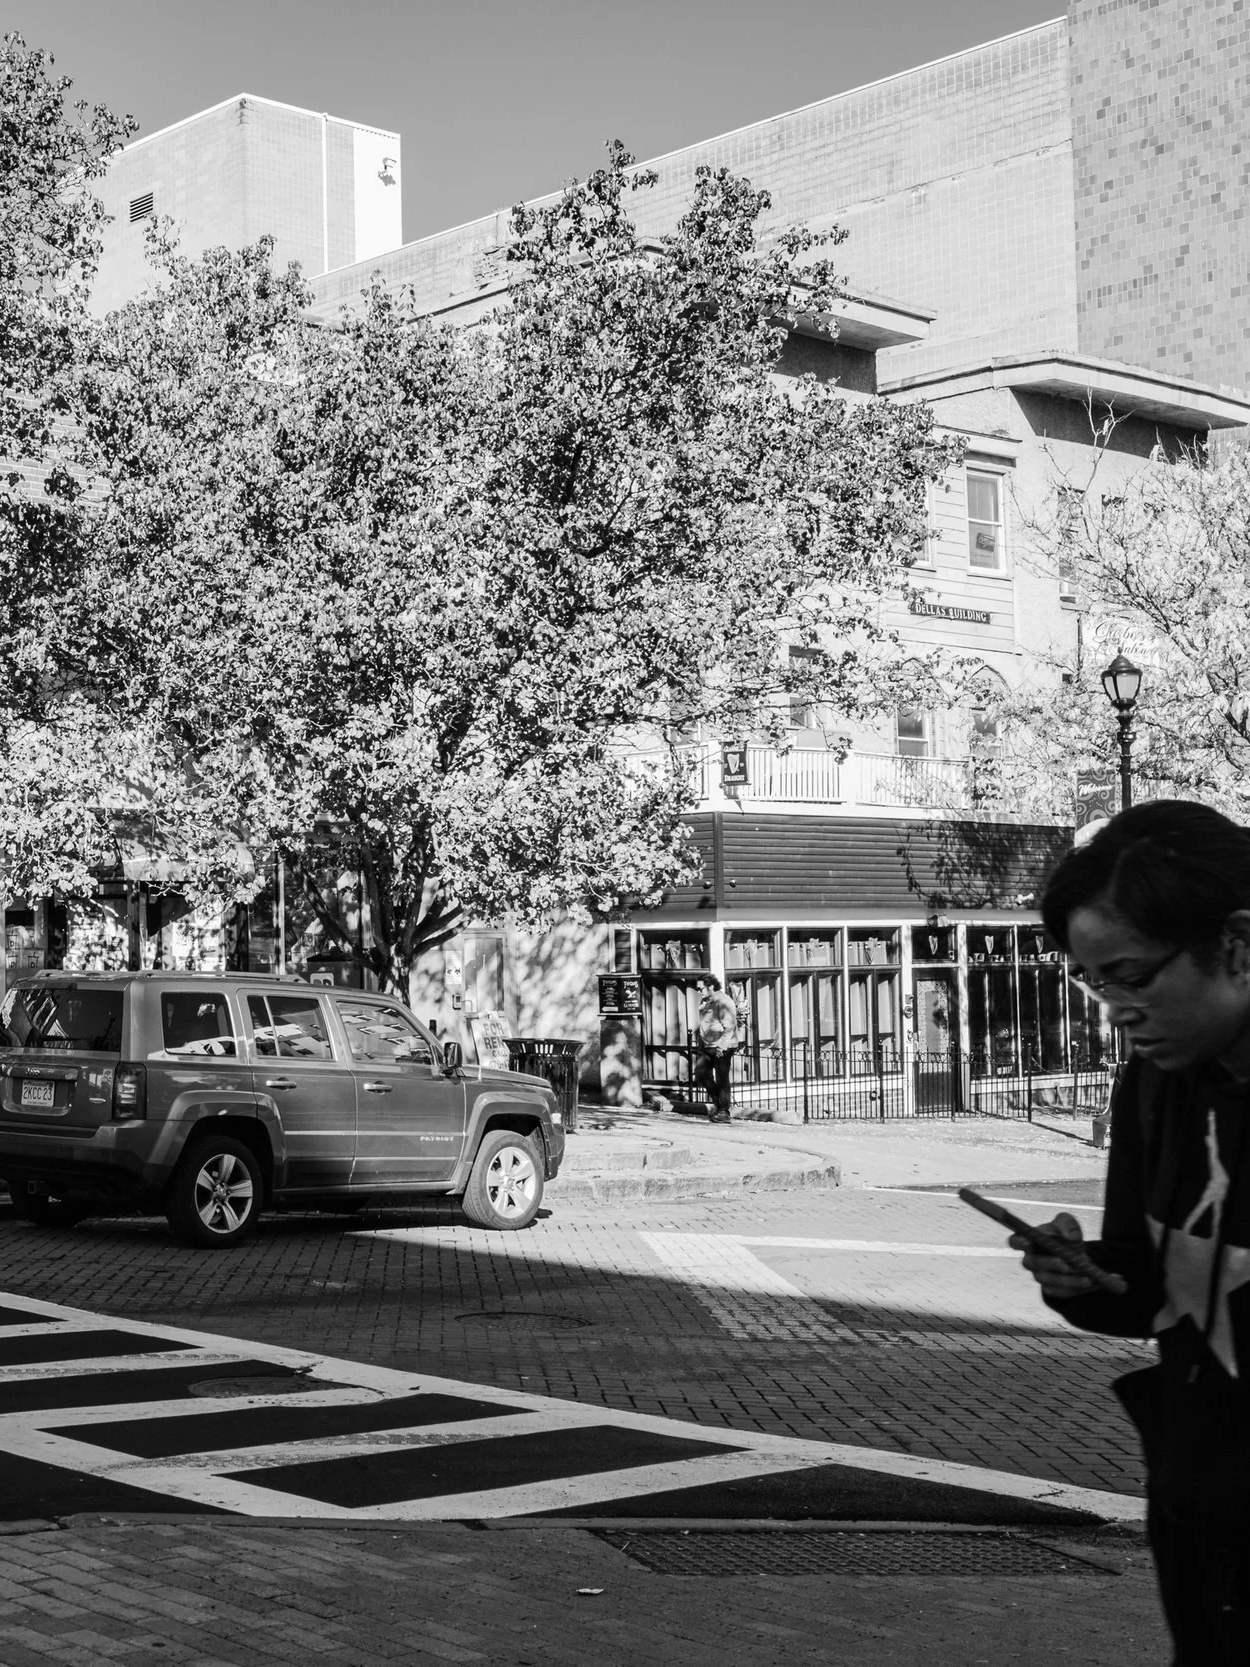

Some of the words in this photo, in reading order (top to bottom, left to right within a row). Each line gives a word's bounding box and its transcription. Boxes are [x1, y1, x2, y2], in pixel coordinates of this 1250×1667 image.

[915, 603, 946, 616] DELLAS
[483, 1022, 505, 1036] FOR
[484, 1036, 509, 1050] REN
[23, 1086, 42, 1100] 2KCC
[42, 1088, 53, 1101] 23
